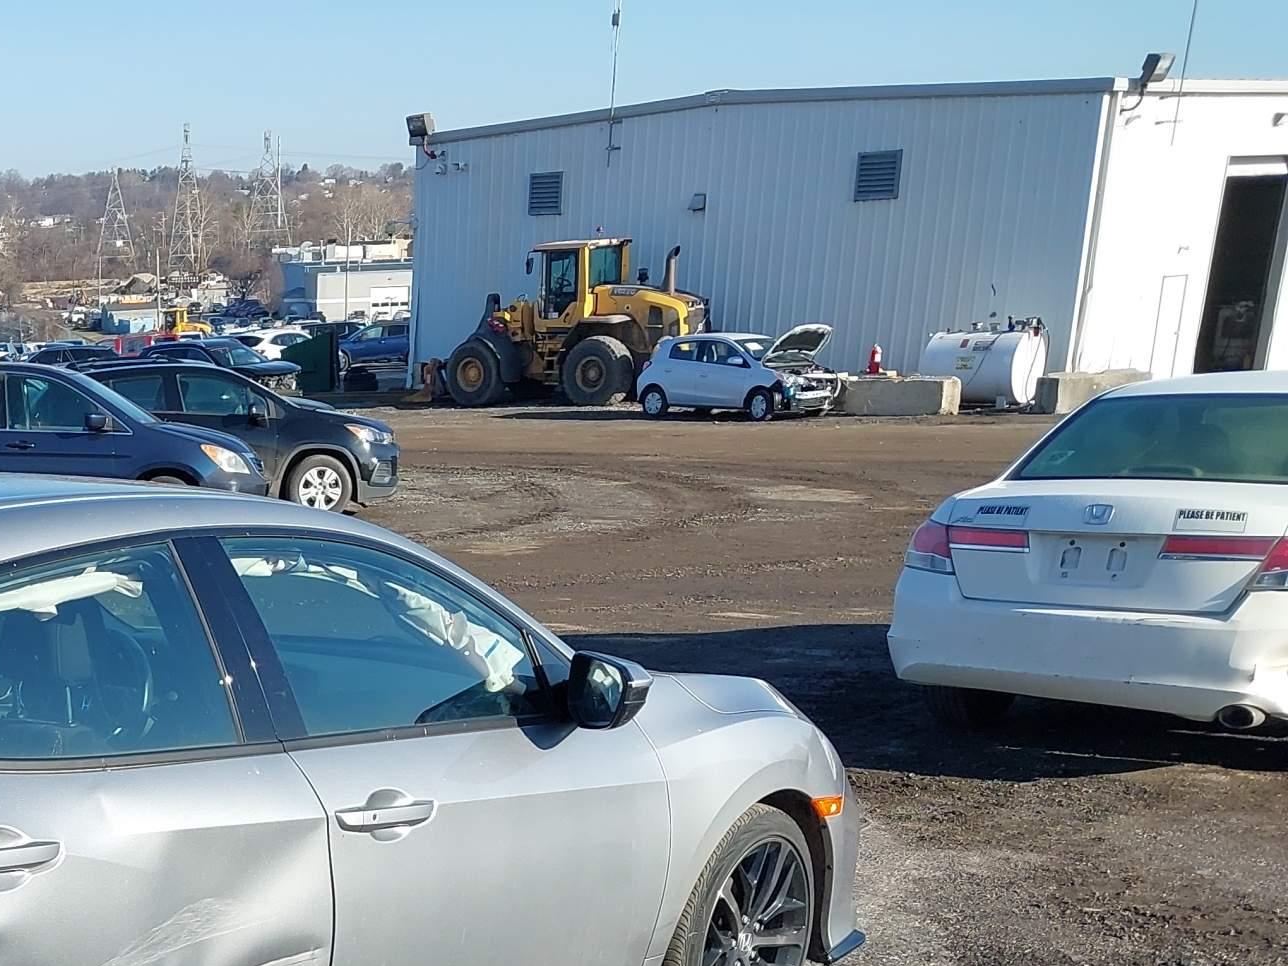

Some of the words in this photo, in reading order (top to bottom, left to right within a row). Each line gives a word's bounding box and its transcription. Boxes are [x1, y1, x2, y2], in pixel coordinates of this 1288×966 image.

[1178, 510, 1204, 519] PLEASE
[1205, 511, 1214, 520] BE
[1215, 511, 1245, 521] PATIENT
